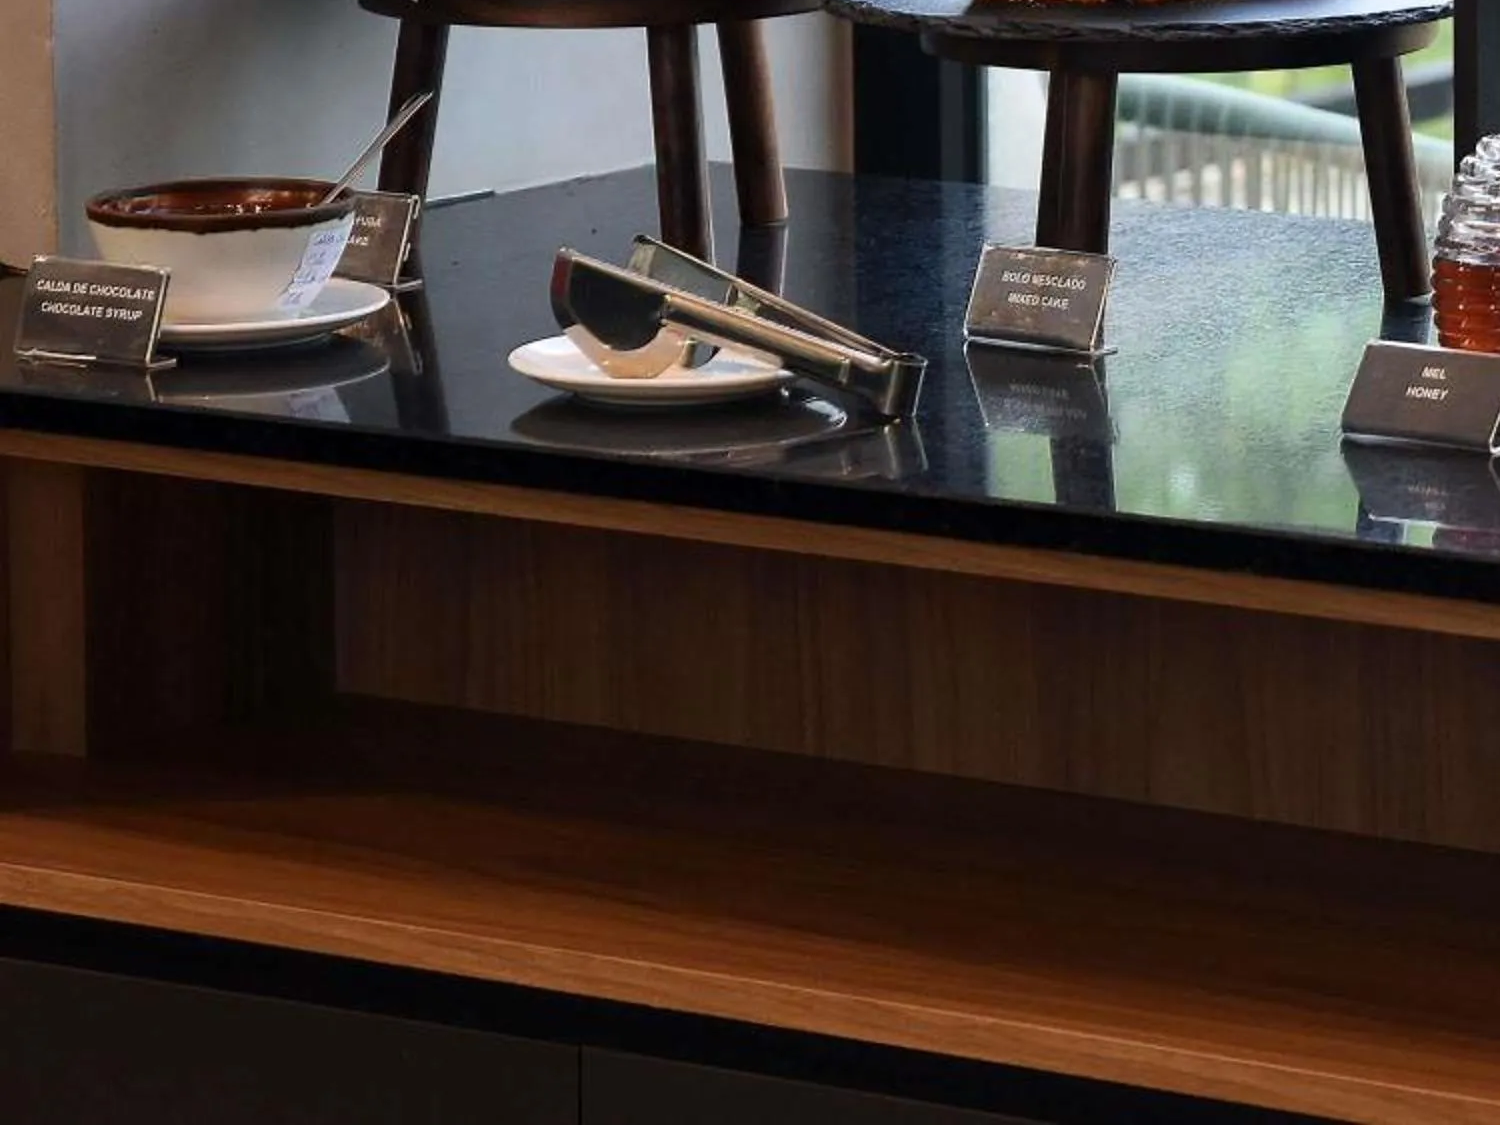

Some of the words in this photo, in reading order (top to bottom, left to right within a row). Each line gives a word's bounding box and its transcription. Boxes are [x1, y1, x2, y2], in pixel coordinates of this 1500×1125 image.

[37, 278, 71, 292] CALDA
[72, 282, 89, 294] DE
[89, 283, 155, 301] CHOCOLATE
[1002, 270, 1031, 284] BOLO
[1032, 274, 1087, 291] MESCLADO
[41, 301, 104, 318] CHOCOLATE
[105, 308, 143, 321] SYRUP
[1008, 292, 1040, 306] MIXED
[1041, 296, 1069, 311] CAKE
[1421, 366, 1447, 380] MEL
[1406, 385, 1448, 402] HONEY
